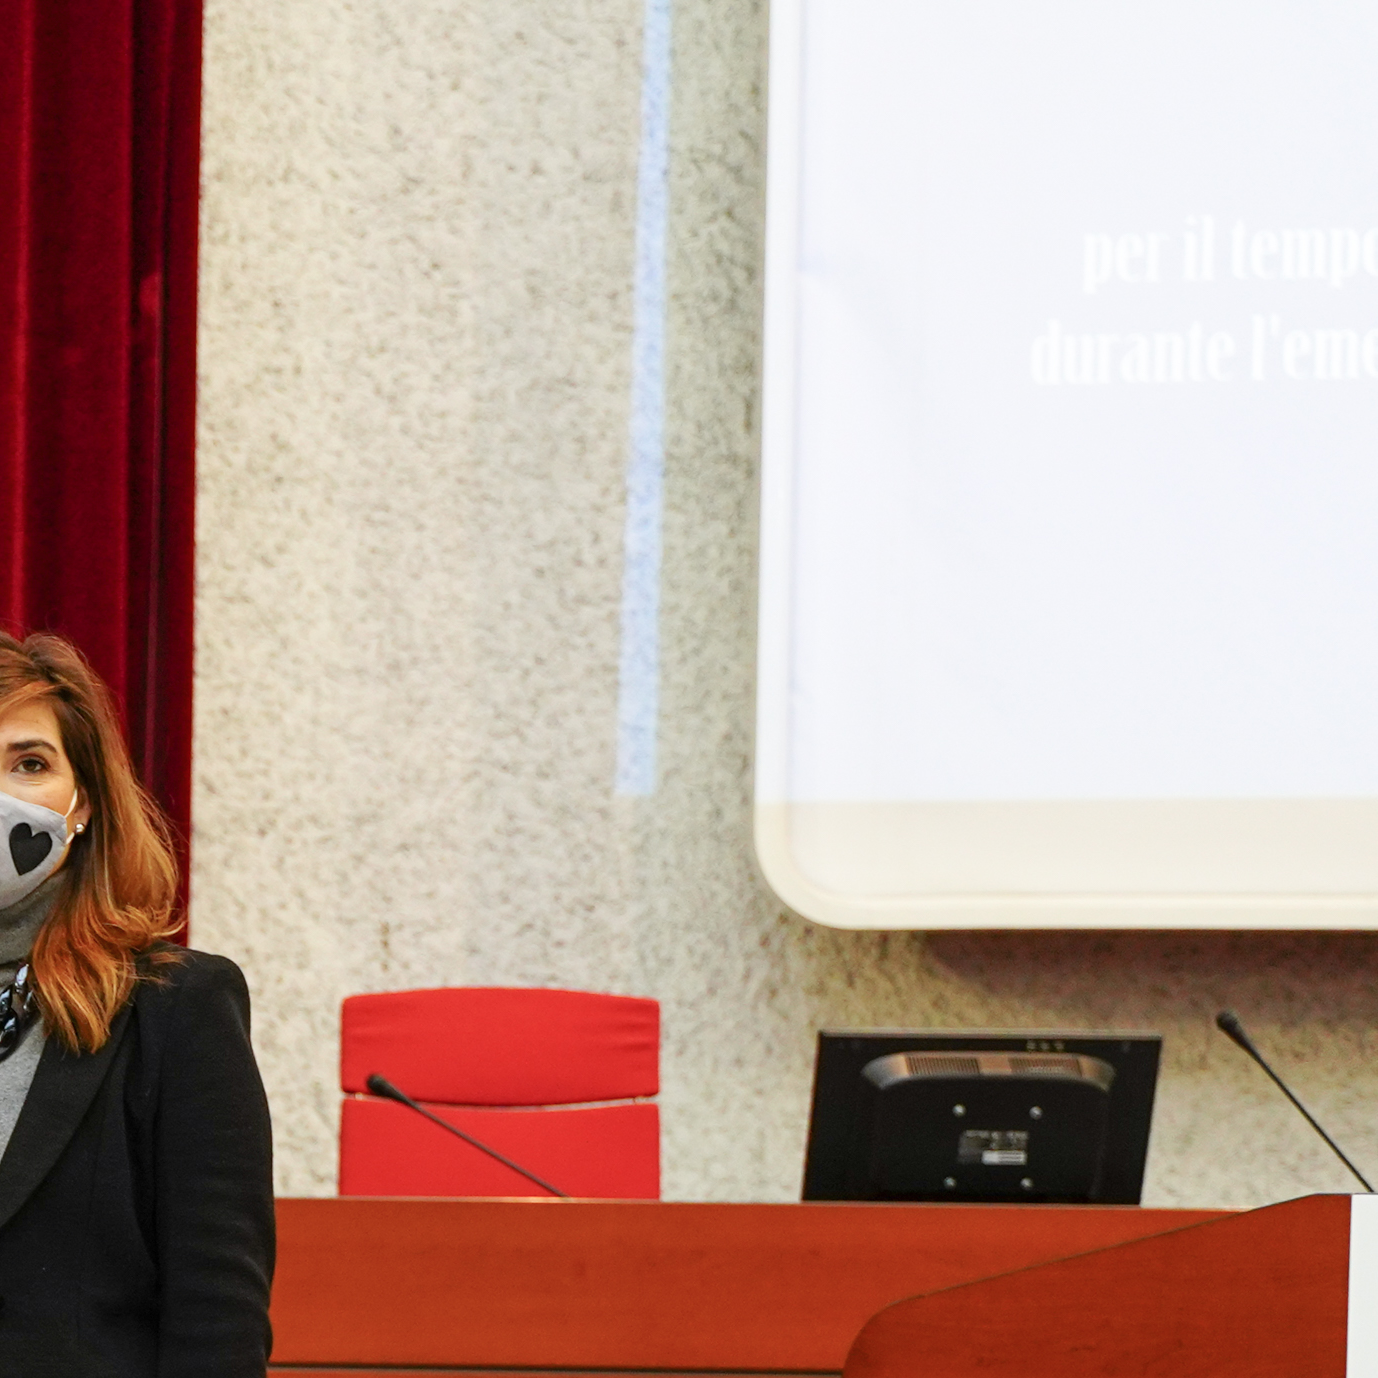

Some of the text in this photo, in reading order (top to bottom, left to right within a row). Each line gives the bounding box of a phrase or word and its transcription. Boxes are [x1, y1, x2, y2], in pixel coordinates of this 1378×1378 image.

[1083, 230, 1169, 294] per
[1183, 214, 1215, 281] il
[1029, 319, 1236, 386] durante
